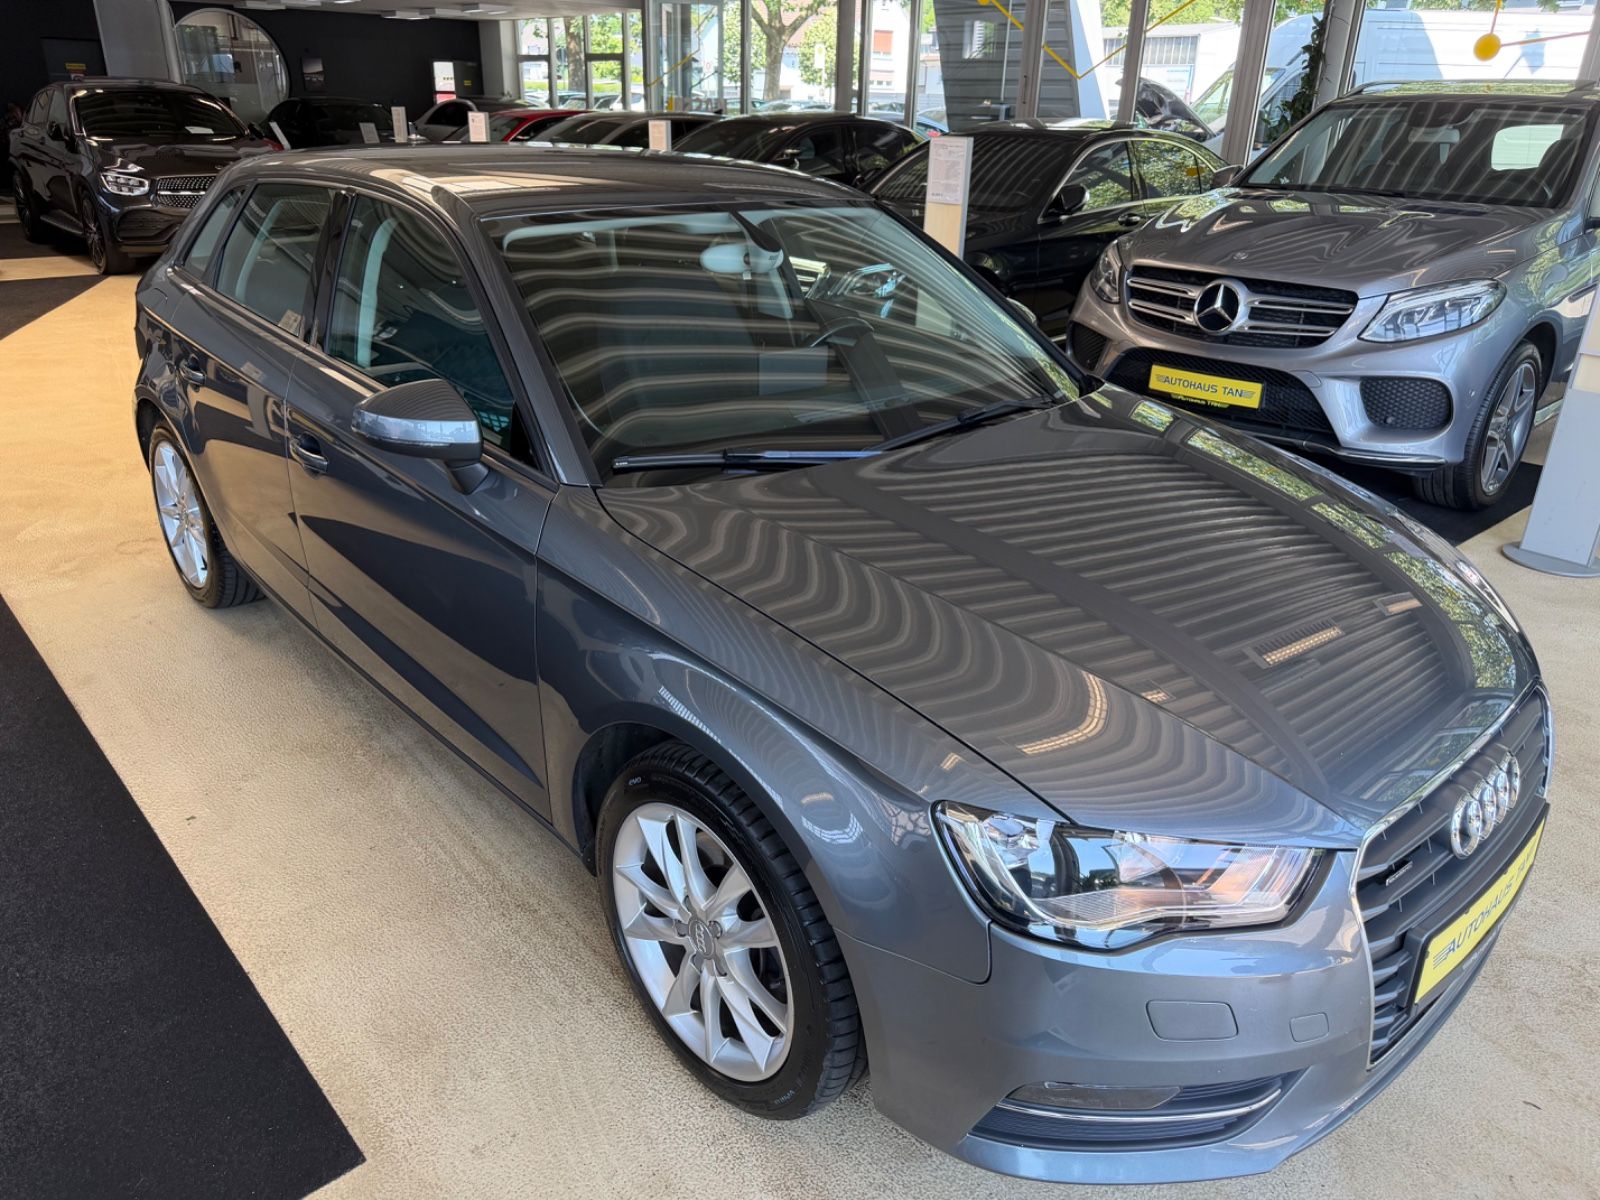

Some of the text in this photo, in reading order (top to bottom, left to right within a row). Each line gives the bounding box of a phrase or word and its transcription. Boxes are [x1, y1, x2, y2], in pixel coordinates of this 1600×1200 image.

[1164, 376, 1244, 398] AUTOHAUS TAN
[1445, 875, 1515, 954] AUTOHAUS
